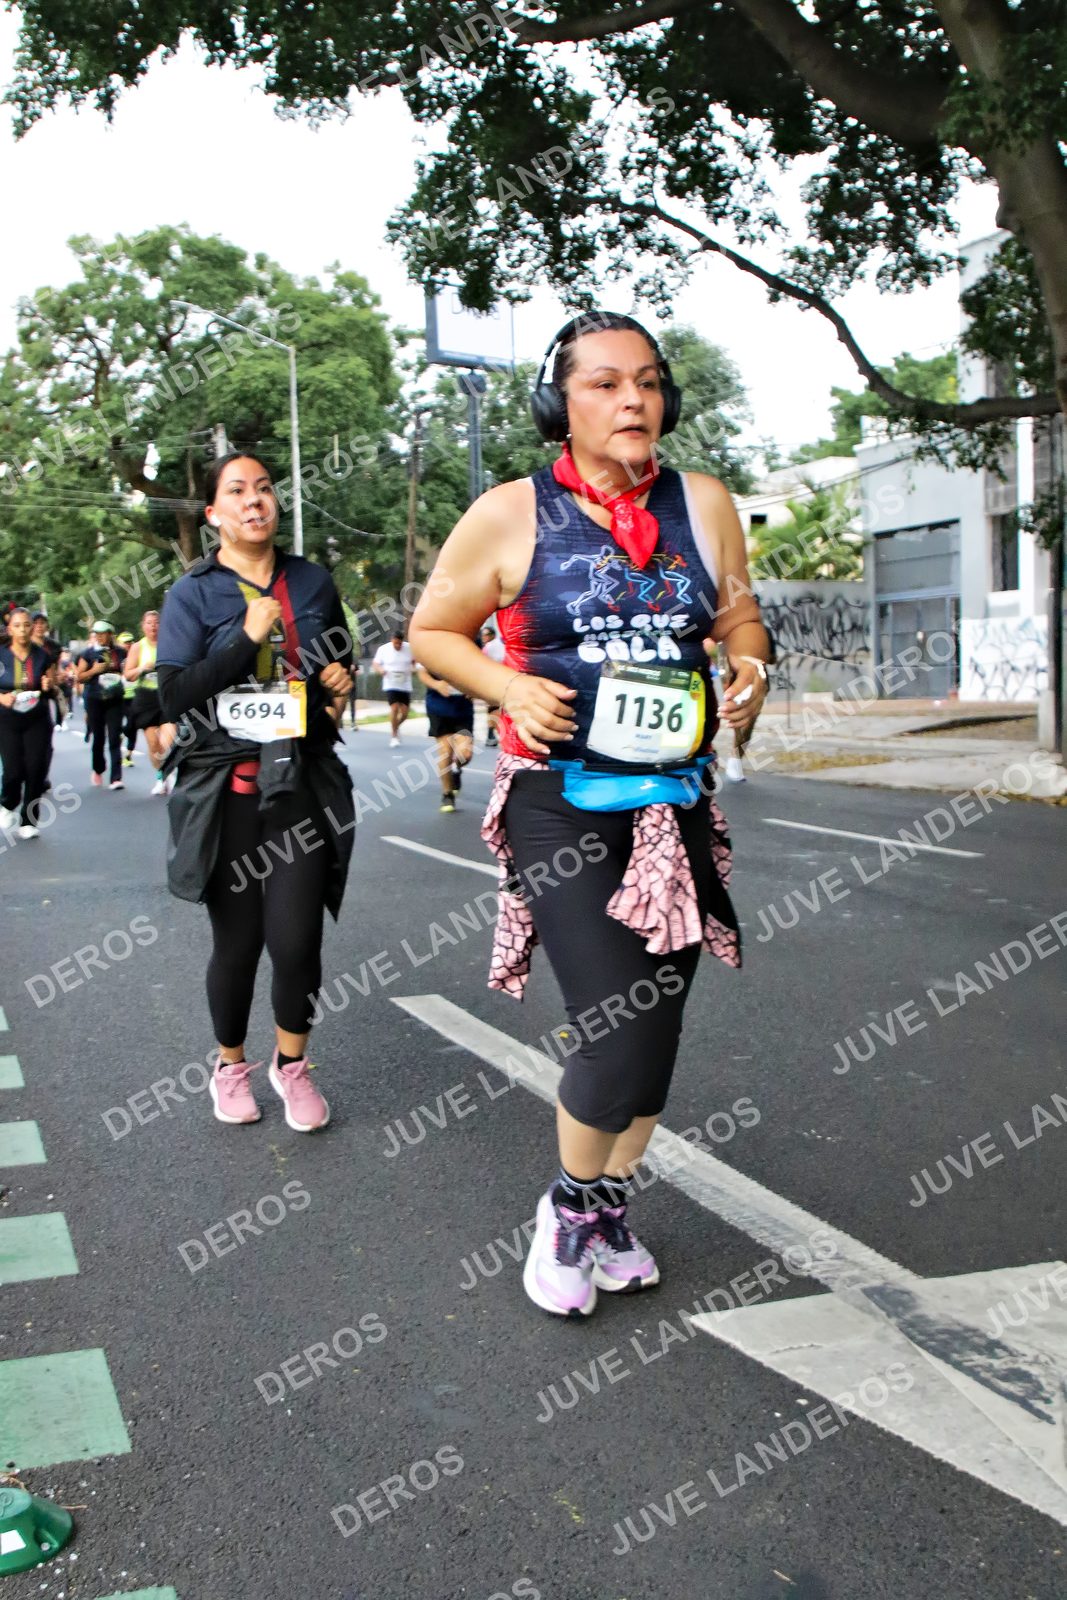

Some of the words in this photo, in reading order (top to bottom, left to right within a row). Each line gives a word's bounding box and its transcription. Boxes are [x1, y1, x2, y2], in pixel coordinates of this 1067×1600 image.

[573, 615, 624, 632] LOS
[630, 613, 690, 631] QUE
[229, 701, 286, 720] 6694
[615, 692, 683, 733] 1136
